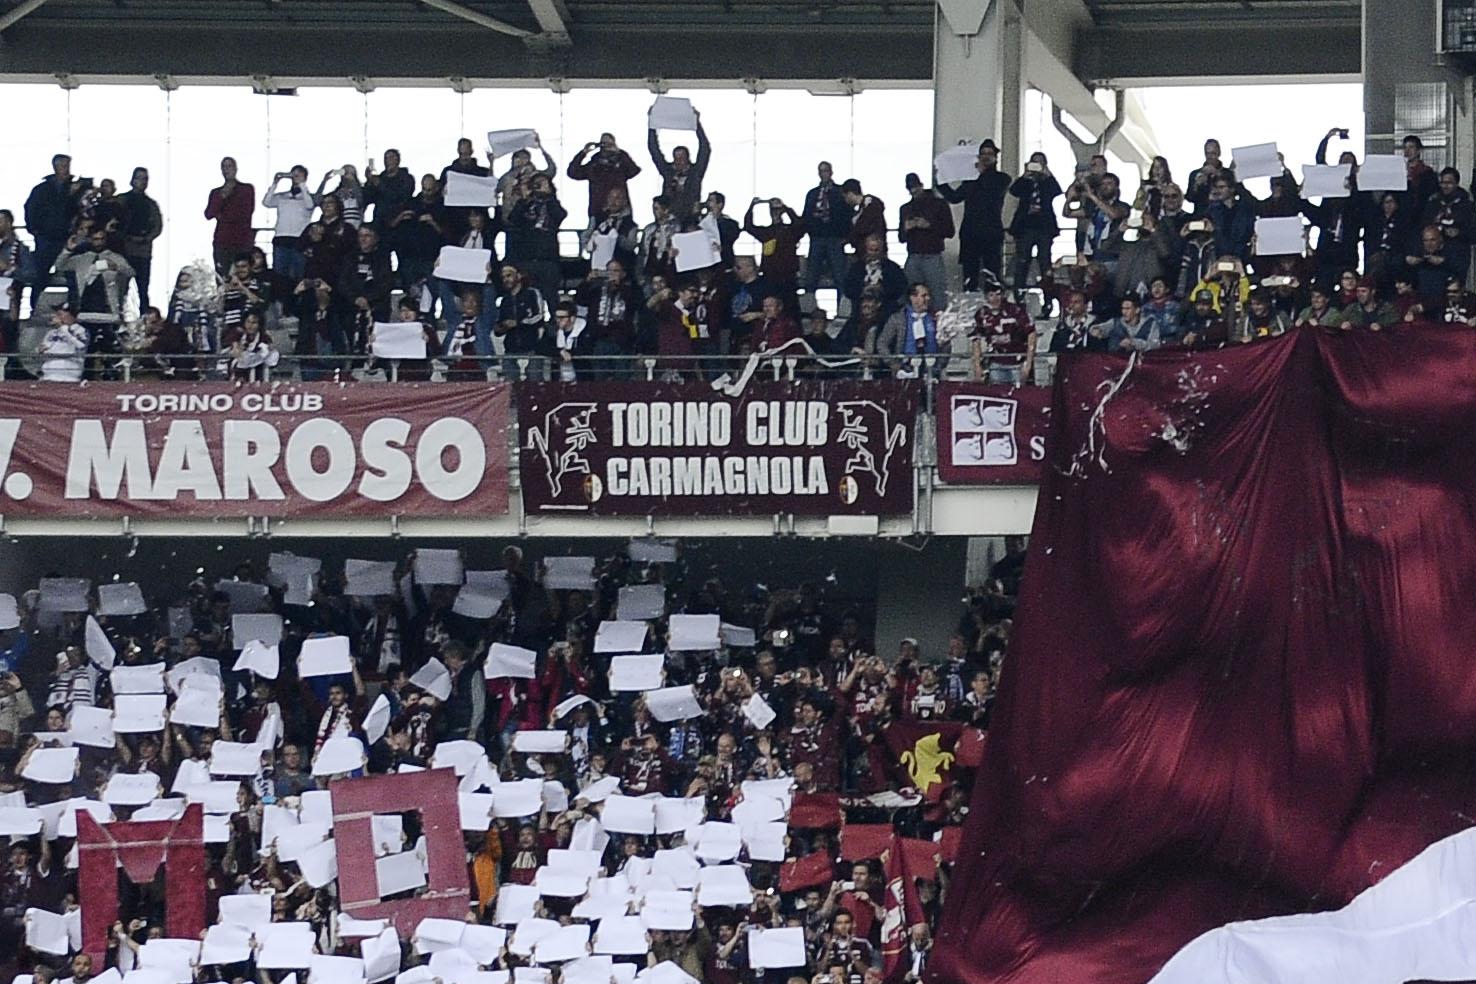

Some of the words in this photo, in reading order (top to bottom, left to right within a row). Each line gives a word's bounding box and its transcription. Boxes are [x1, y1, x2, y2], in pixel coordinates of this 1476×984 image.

[118, 394, 234, 412] TORINO
[240, 394, 323, 412] CLUB
[608, 402, 732, 446] TORINO
[746, 402, 828, 446] CLUB
[65, 417, 486, 501] MAROSO
[606, 456, 828, 496] CARMAGNOLA
